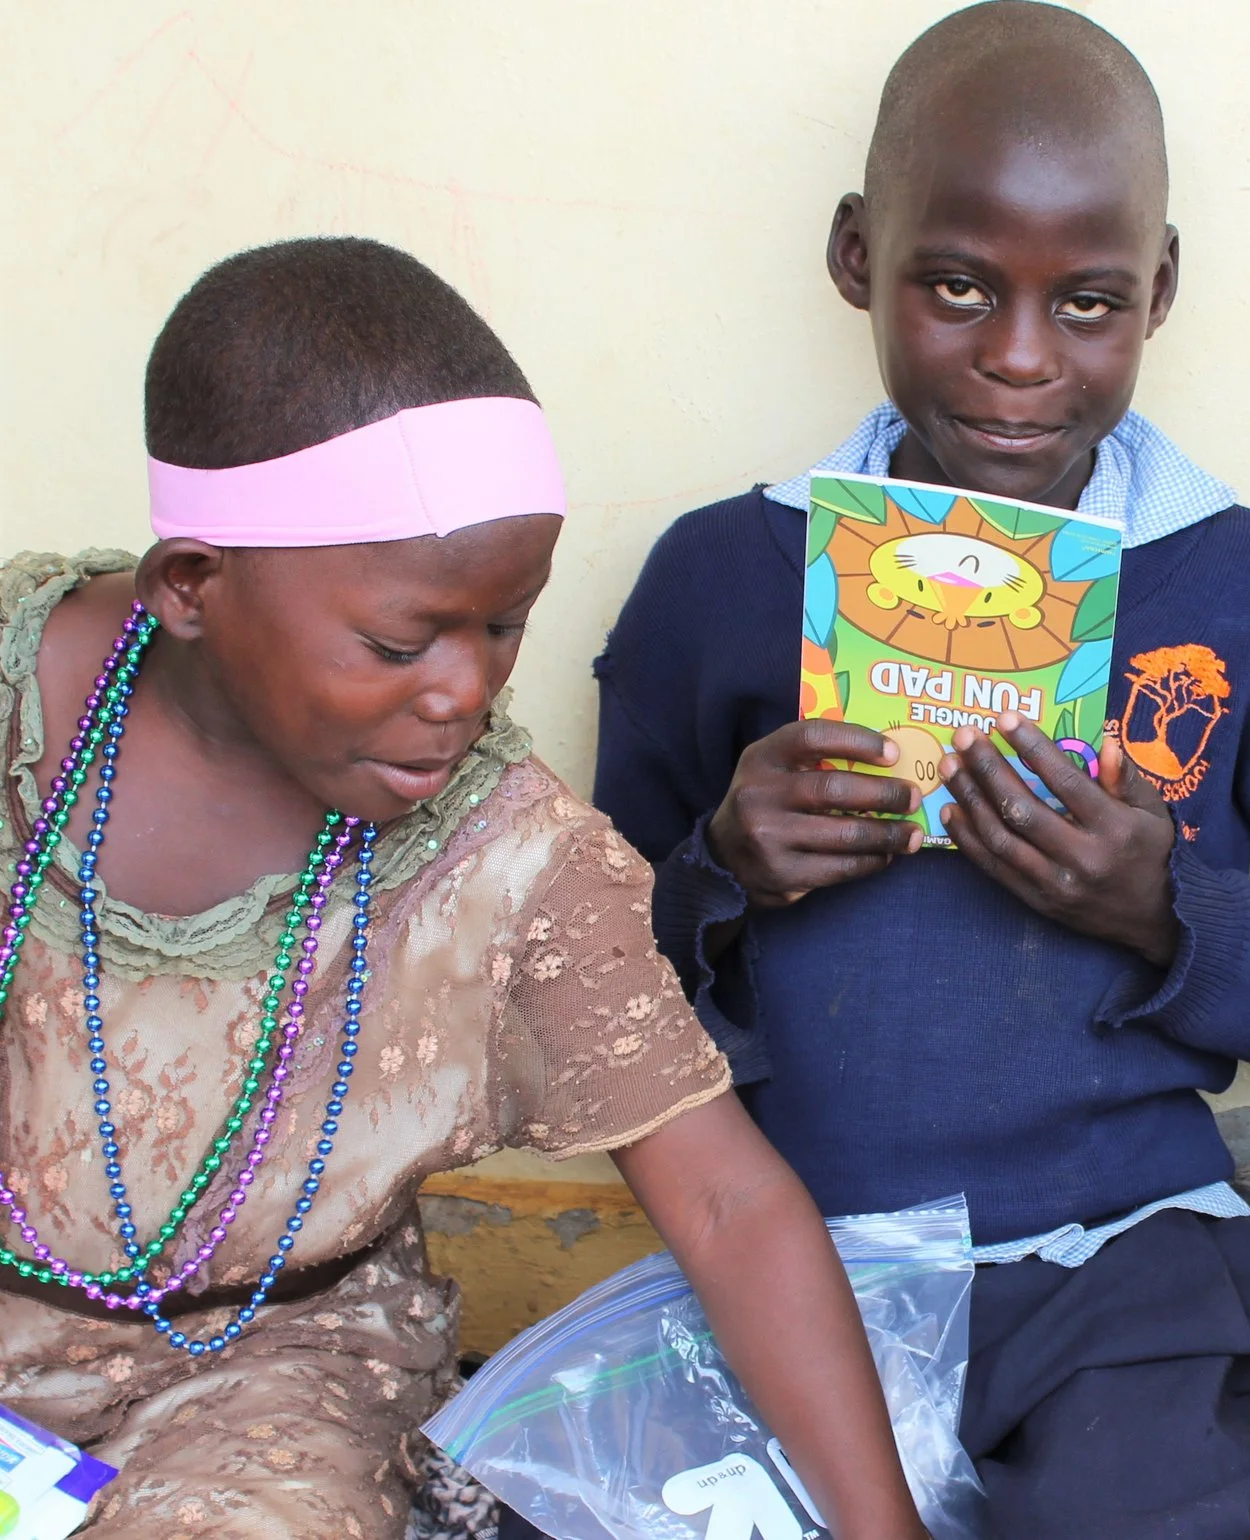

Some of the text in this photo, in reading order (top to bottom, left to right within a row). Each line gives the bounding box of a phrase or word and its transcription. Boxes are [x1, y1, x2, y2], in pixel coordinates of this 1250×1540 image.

[870, 661, 1042, 721] FUN PAD
[911, 702, 996, 735] JUNGLE
